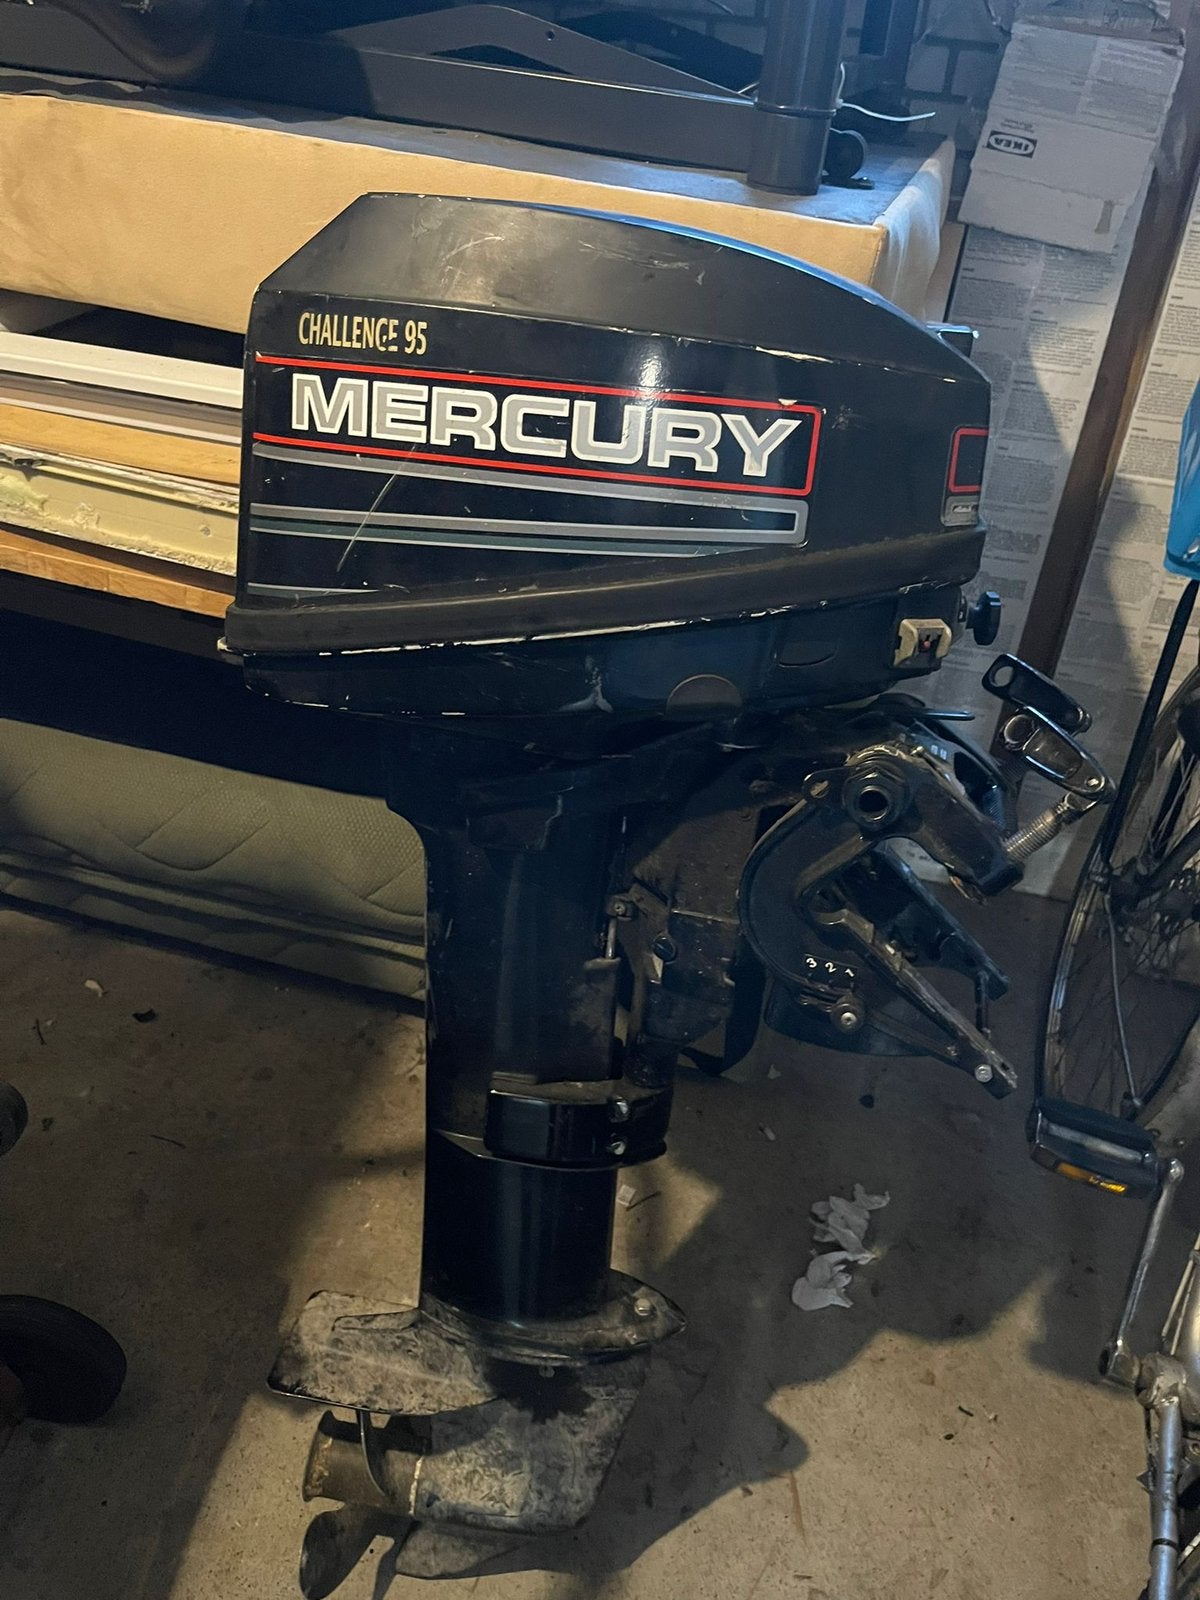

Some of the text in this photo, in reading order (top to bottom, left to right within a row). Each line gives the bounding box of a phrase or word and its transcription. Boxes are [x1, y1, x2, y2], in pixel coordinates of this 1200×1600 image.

[994, 136, 1029, 152] IKEA
[298, 312, 428, 355] CHALLENGE 95
[292, 373, 802, 477] MERCURY
[805, 957, 855, 978] 3 2 1
